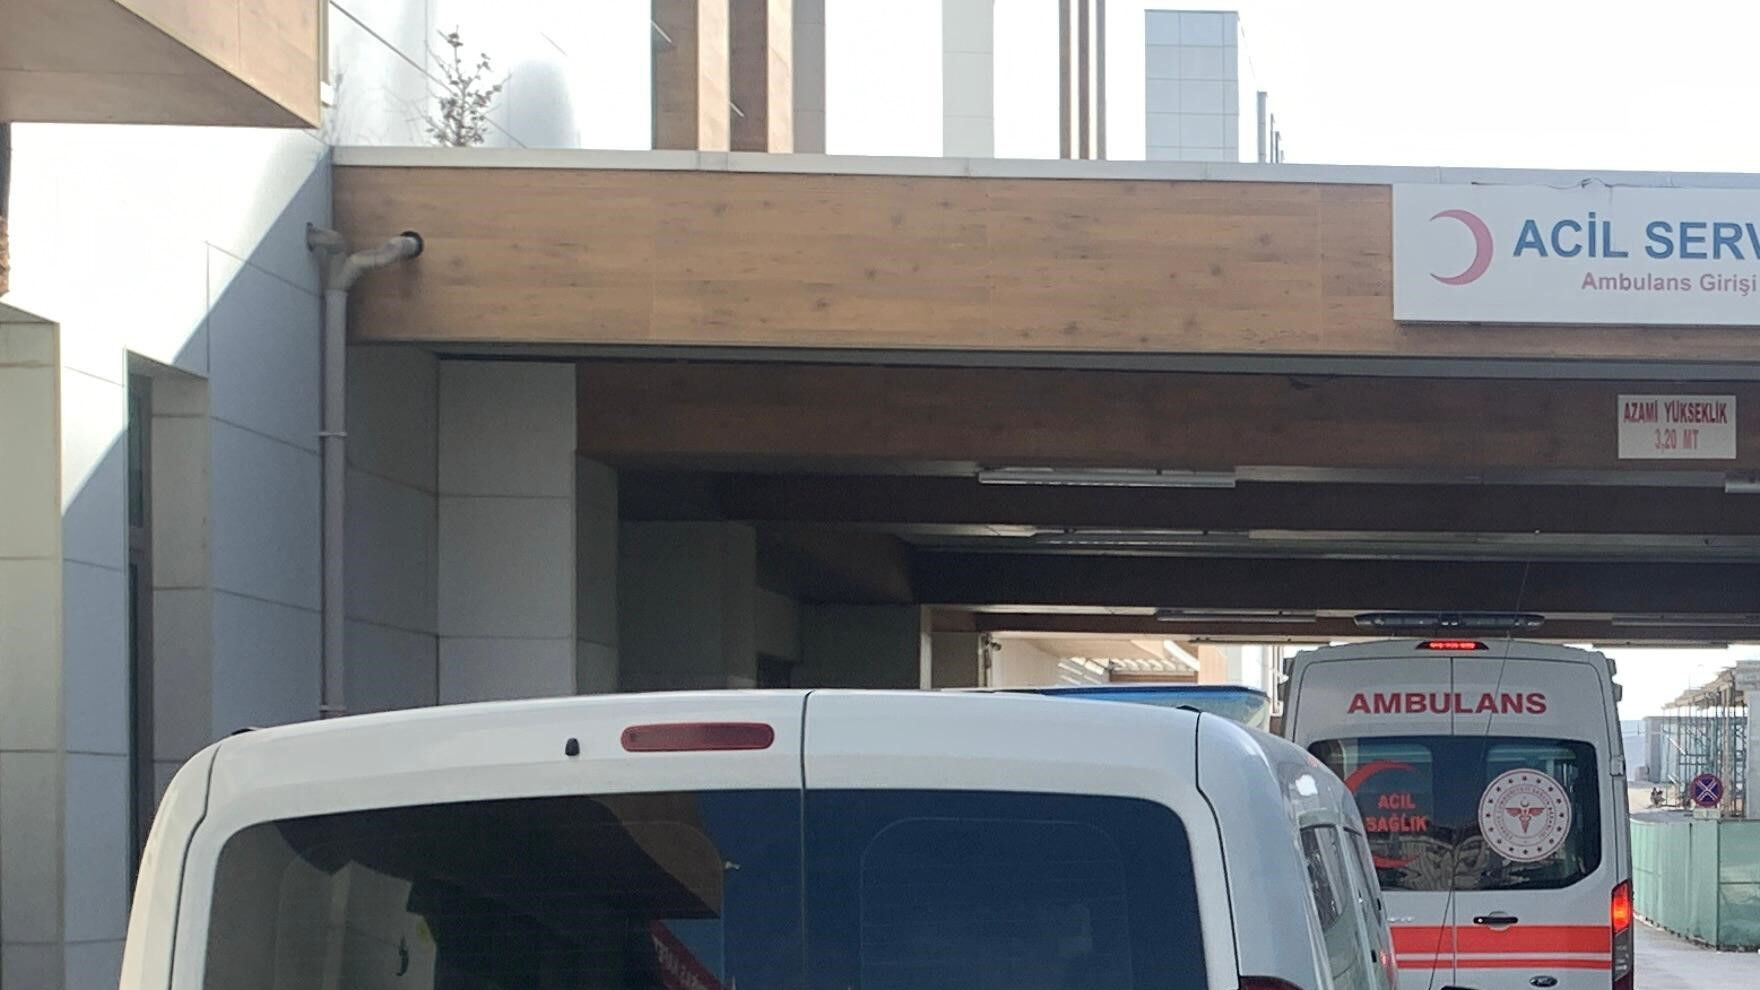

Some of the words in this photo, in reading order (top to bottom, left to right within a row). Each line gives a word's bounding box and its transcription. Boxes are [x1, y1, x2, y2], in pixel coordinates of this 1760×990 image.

[1512, 211, 1629, 258] ACİL
[1581, 272, 1692, 292] Ambulans
[1699, 273, 1757, 296] Girişi
[1347, 692, 1547, 714] AMBULANS
